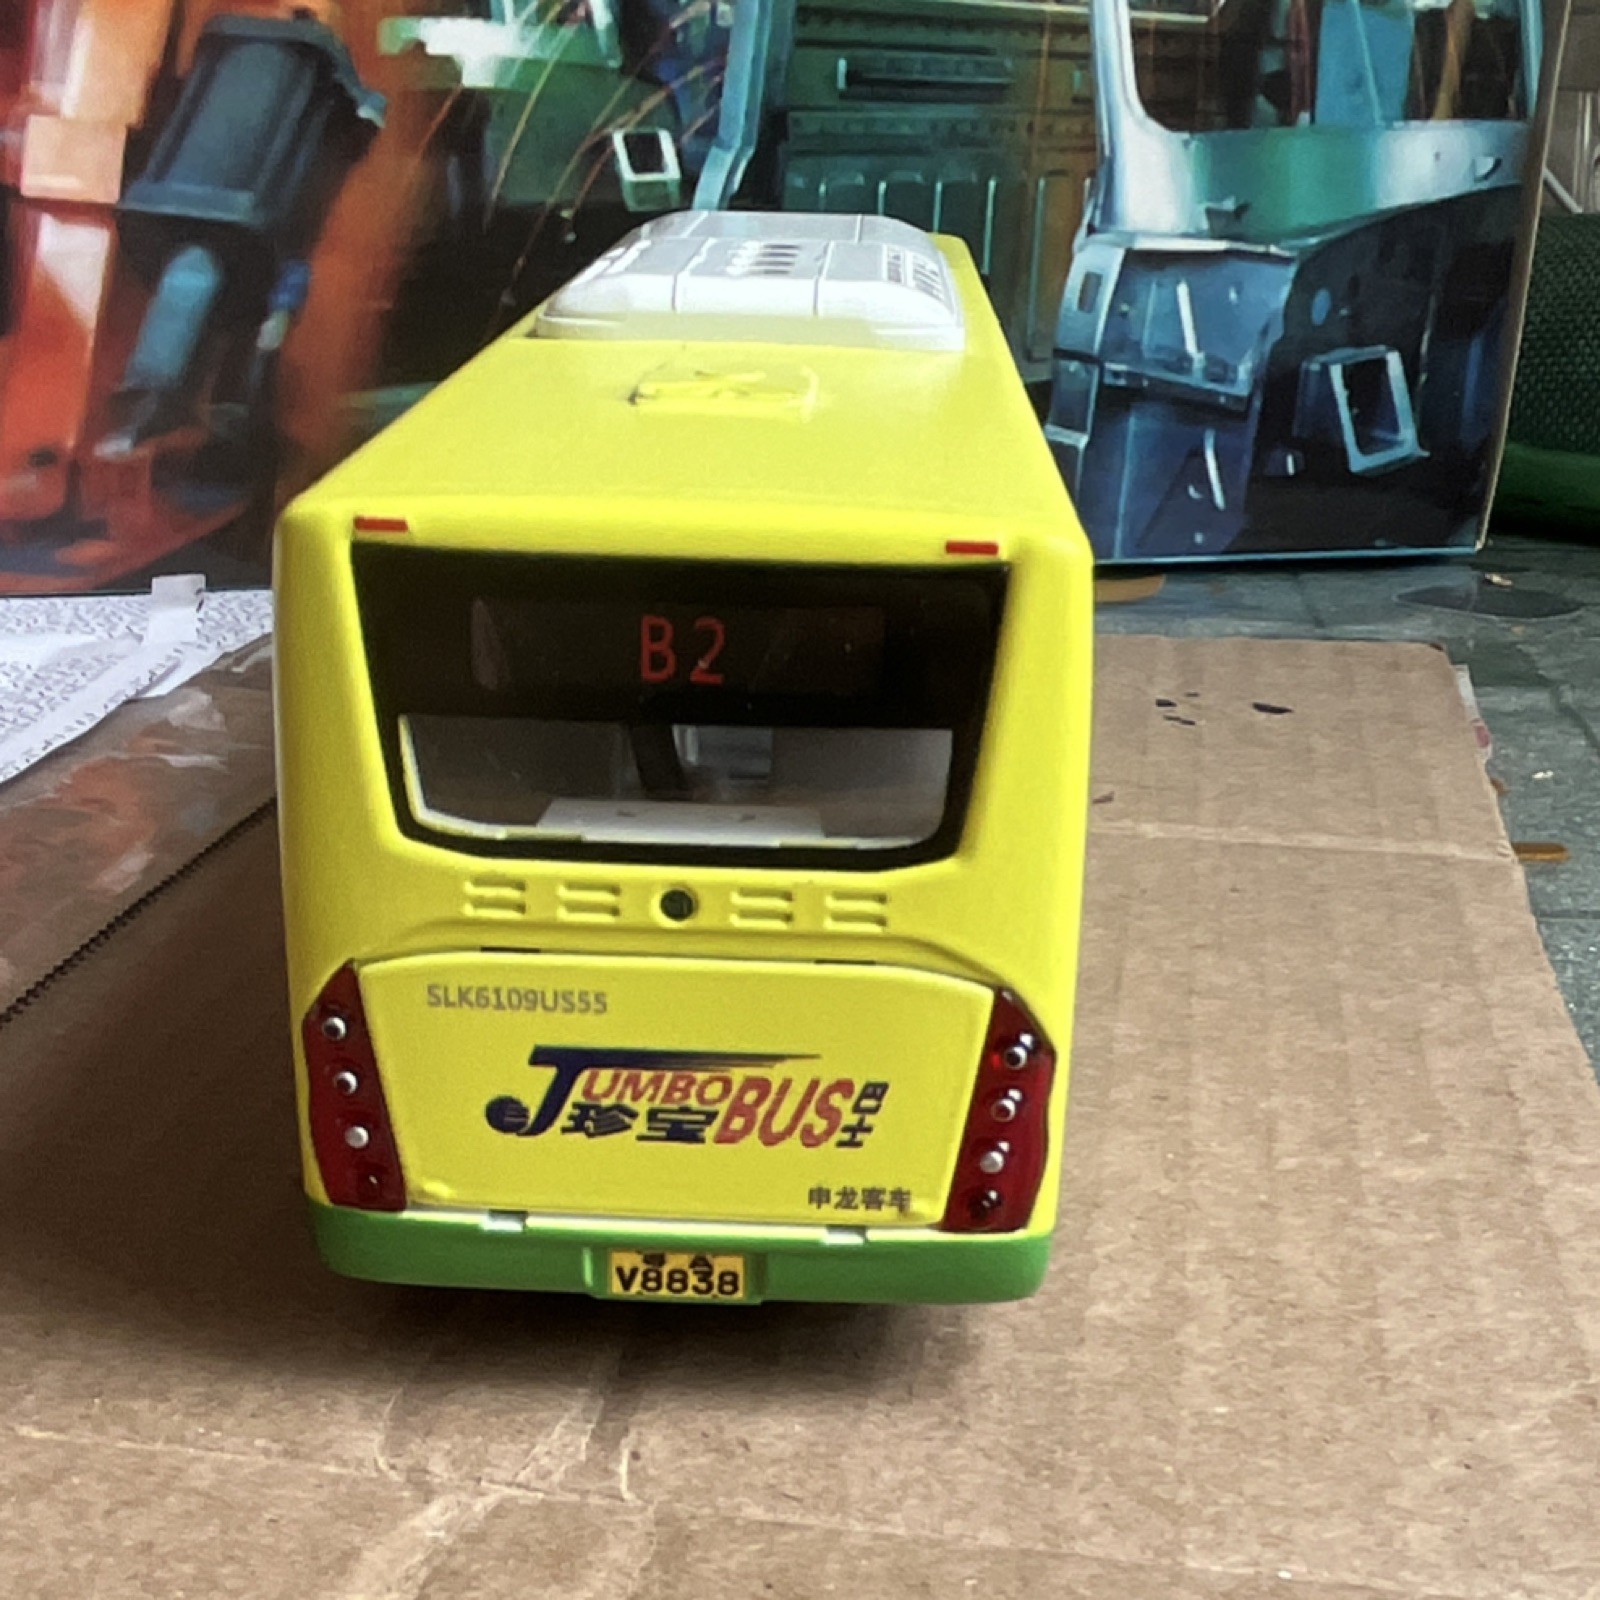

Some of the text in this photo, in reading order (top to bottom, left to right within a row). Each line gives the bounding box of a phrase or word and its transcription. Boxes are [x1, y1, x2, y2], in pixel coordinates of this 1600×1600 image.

[640, 614, 726, 685] B2
[427, 983, 608, 1015] SLK6109US55
[560, 1102, 719, 1144] 珍宝
[713, 1075, 856, 1148] BUS
[836, 1081, 889, 1148] 巴士
[807, 1185, 912, 1214] 申龙客车
[615, 1265, 740, 1295] V8838
